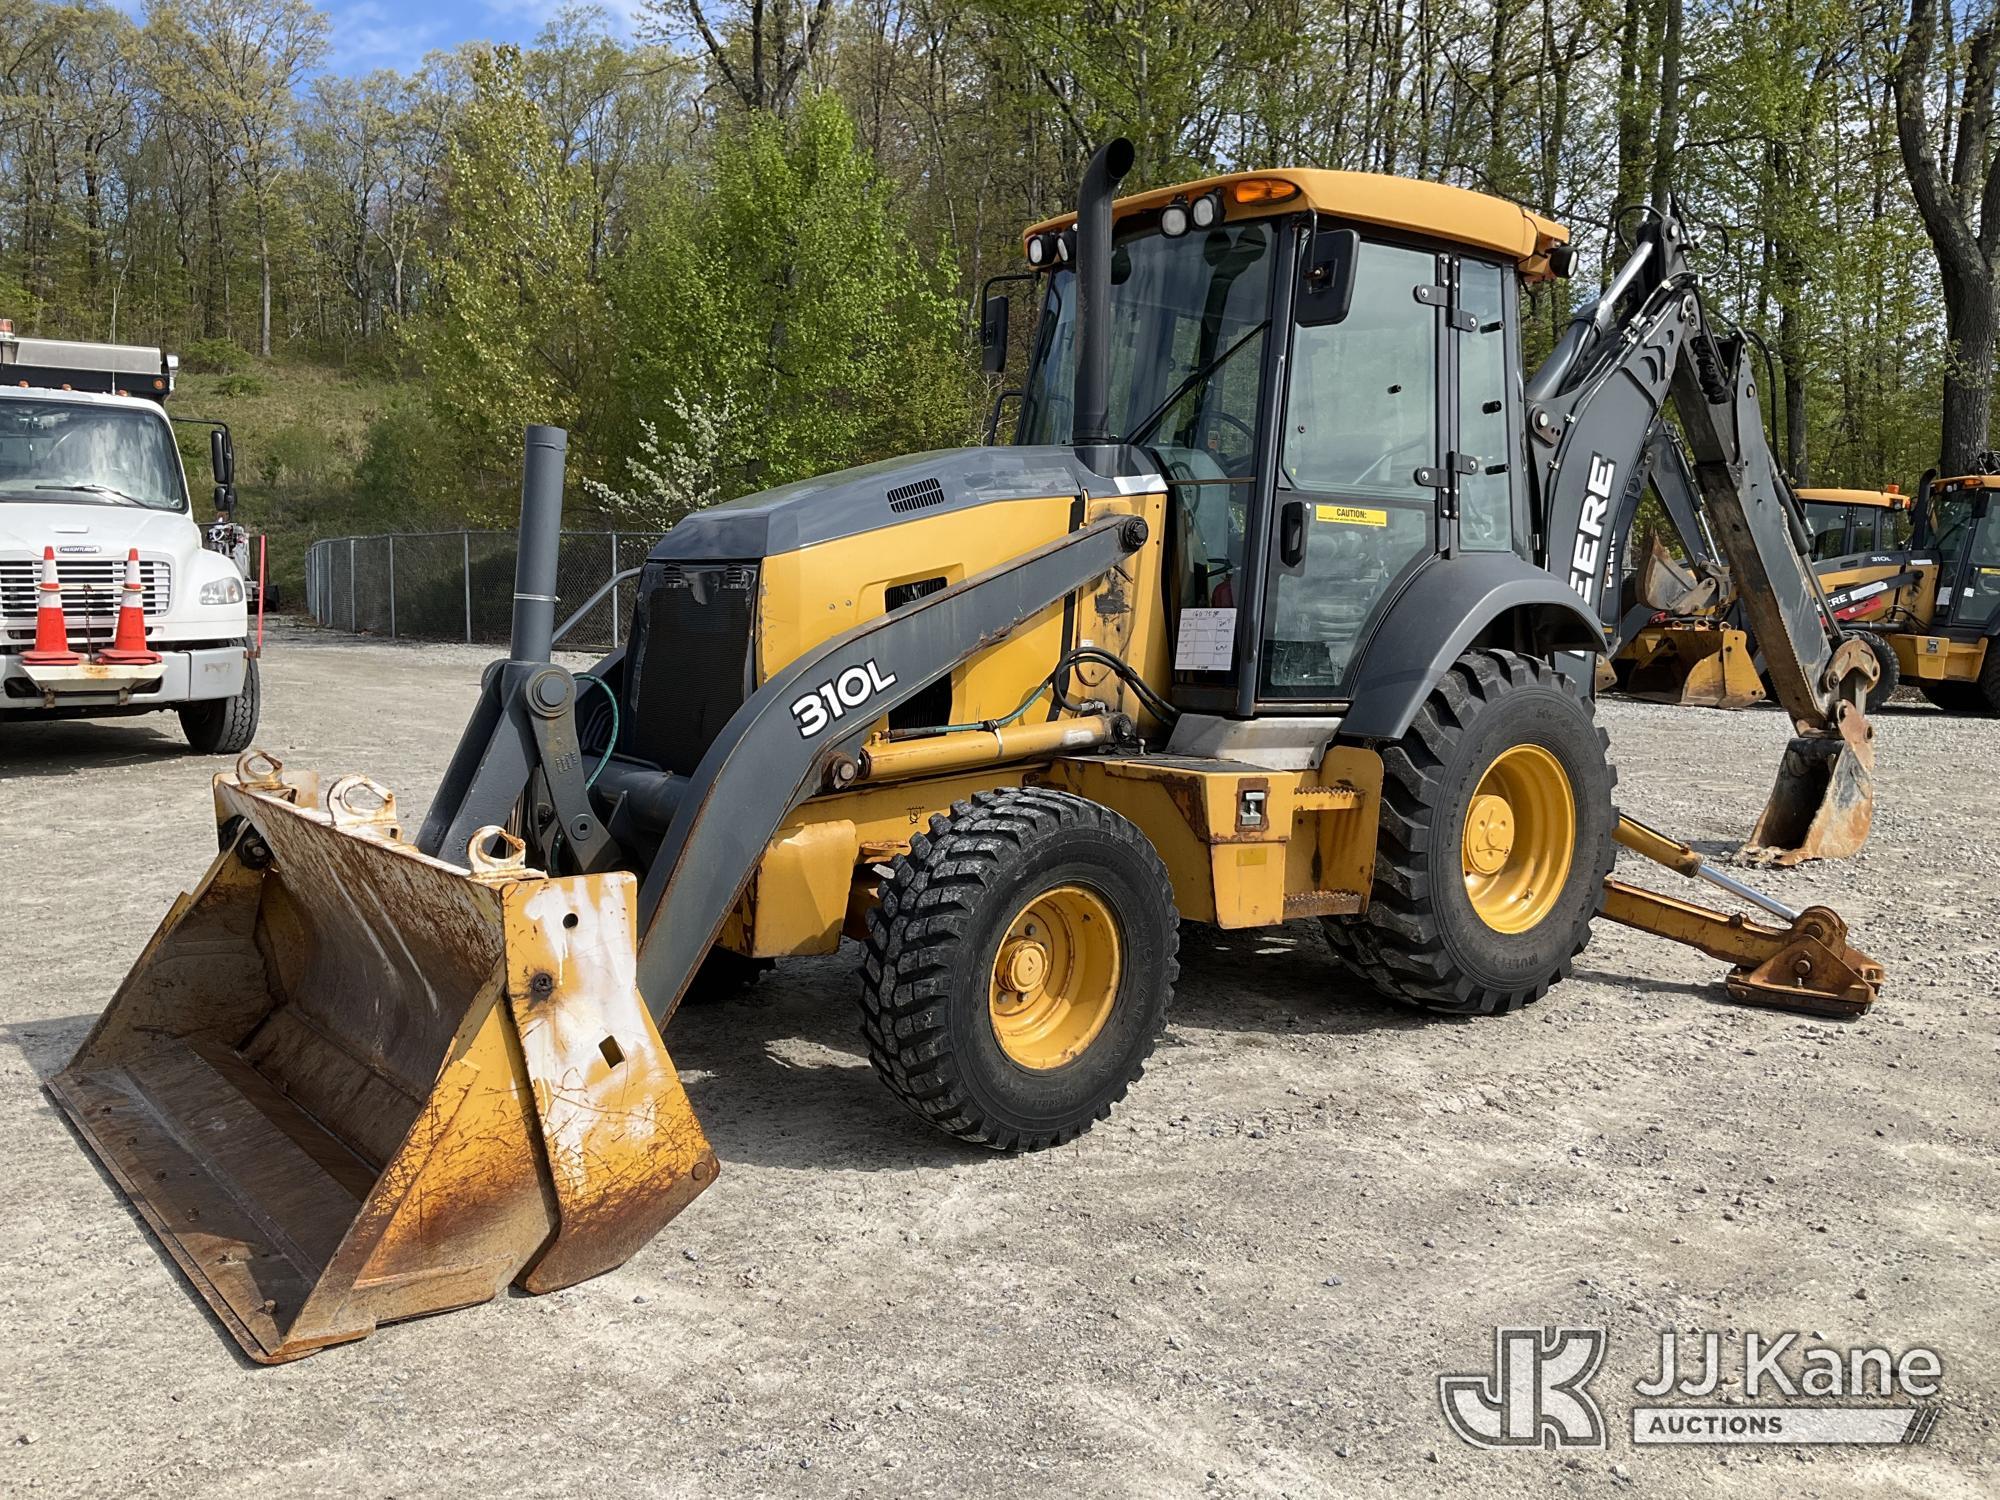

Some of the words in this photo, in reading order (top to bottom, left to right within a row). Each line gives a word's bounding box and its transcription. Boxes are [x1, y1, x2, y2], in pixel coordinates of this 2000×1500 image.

[1336, 508, 1367, 519] CAUTION:
[1568, 452, 1616, 606] EERE
[789, 658, 898, 739] 310L
